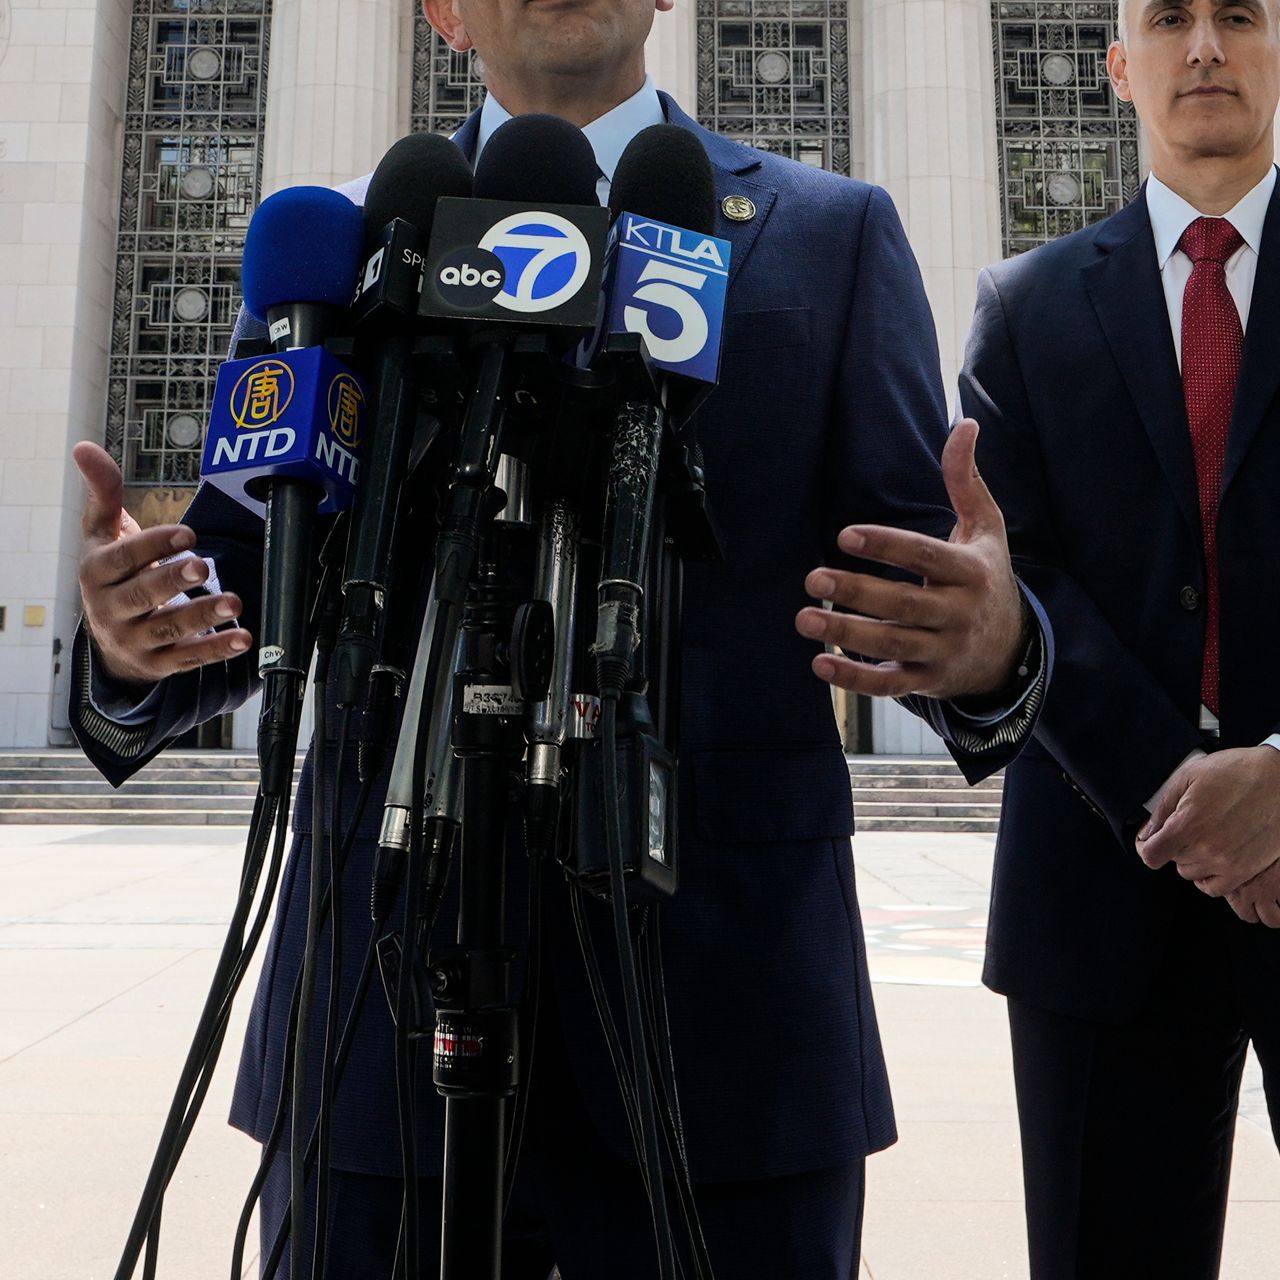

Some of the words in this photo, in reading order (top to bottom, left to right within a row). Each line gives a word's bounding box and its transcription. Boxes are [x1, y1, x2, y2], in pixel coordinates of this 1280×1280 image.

[625, 218, 723, 267] KTLA
[439, 263, 501, 288] abc
[624, 259, 709, 362] 5
[212, 427, 296, 465] NTD
